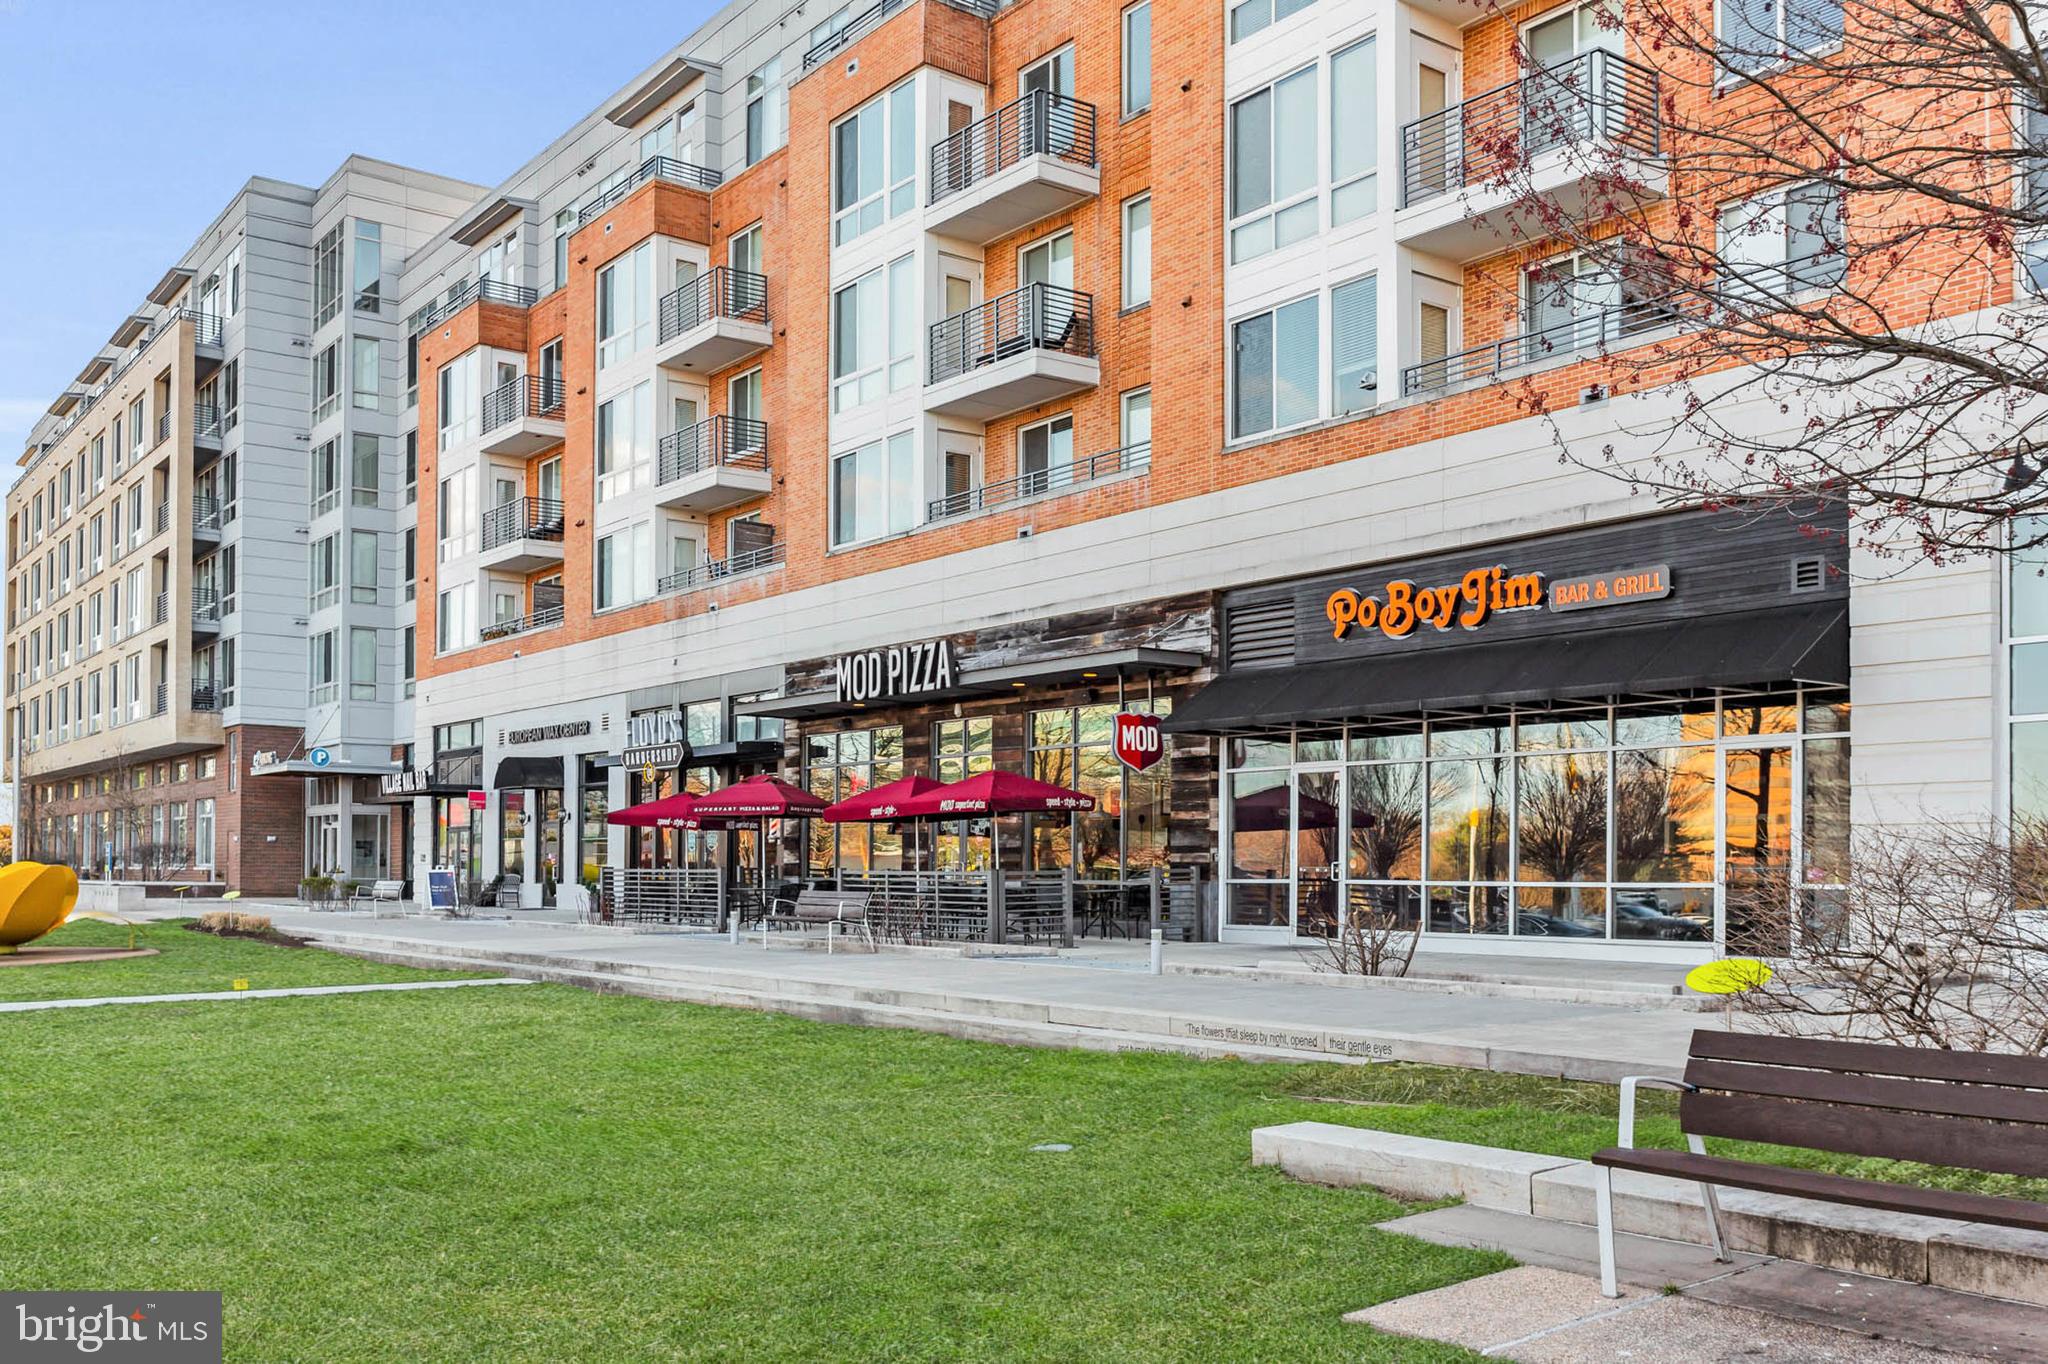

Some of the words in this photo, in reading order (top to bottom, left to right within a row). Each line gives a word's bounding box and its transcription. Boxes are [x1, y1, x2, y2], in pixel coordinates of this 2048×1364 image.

[1555, 582, 1589, 605] BAR
[1595, 580, 1608, 600] &
[1613, 572, 1664, 596] GRILL
[836, 652, 881, 702] MOD
[888, 640, 952, 696] PIZZA
[508, 727, 545, 744] EUROPEAN
[544, 724, 562, 740] WAX
[561, 720, 591, 738] CENTER
[624, 711, 683, 748] FLOYD'S
[1122, 724, 1159, 752] MOD
[625, 747, 678, 767] BARBERSHOP
[694, 805, 737, 813] SUPERFAST
[1187, 1023, 1200, 1036] The
[1201, 1025, 1224, 1039] flowers
[1239, 1029, 1258, 1044] sleep
[1259, 1031, 1268, 1046] by
[1290, 1035, 1318, 1049] opened
[1329, 1036, 1346, 1050] their
[1347, 1039, 1371, 1054] gentle
[1373, 1044, 1393, 1057] eyes
